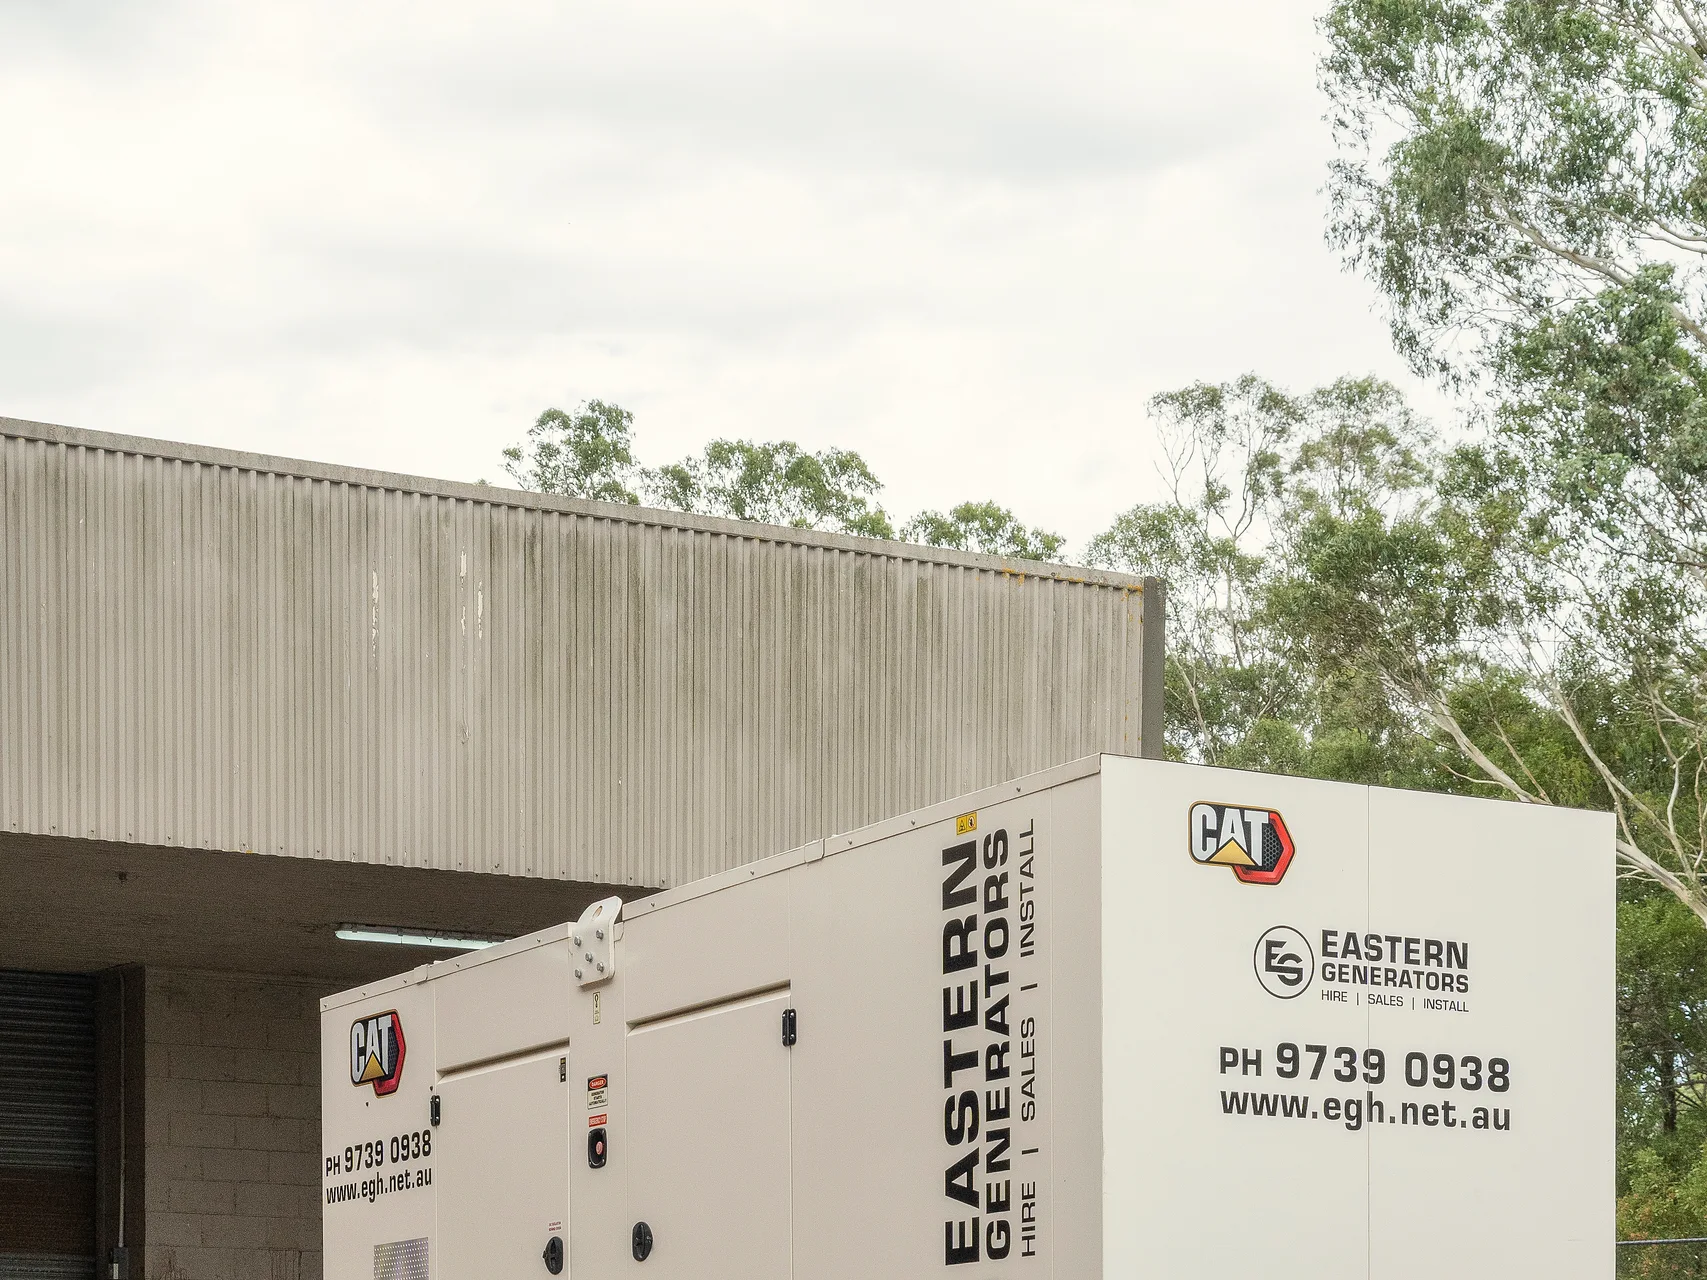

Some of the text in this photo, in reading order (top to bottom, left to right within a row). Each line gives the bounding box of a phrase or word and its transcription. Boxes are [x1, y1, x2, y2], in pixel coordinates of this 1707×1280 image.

[1191, 803, 1270, 867] CAT
[1321, 929, 1469, 969] EASTERN
[1321, 963, 1469, 993] GENERATORS
[1321, 989, 1470, 1013] HIRE SALES INSTALL
[351, 1014, 392, 1083] CAT
[942, 839, 980, 1266] EASTERN
[984, 828, 1012, 1261] GENERATORS
[1019, 818, 1036, 1258] HIRE SALES INSTALL
[1219, 1042, 1511, 1093] PH 9739 0938
[1220, 1089, 1511, 1132] www.egh.net.au
[325, 1129, 432, 1177] PH 9739 0938
[325, 1166, 432, 1205] www.egh.net.au
